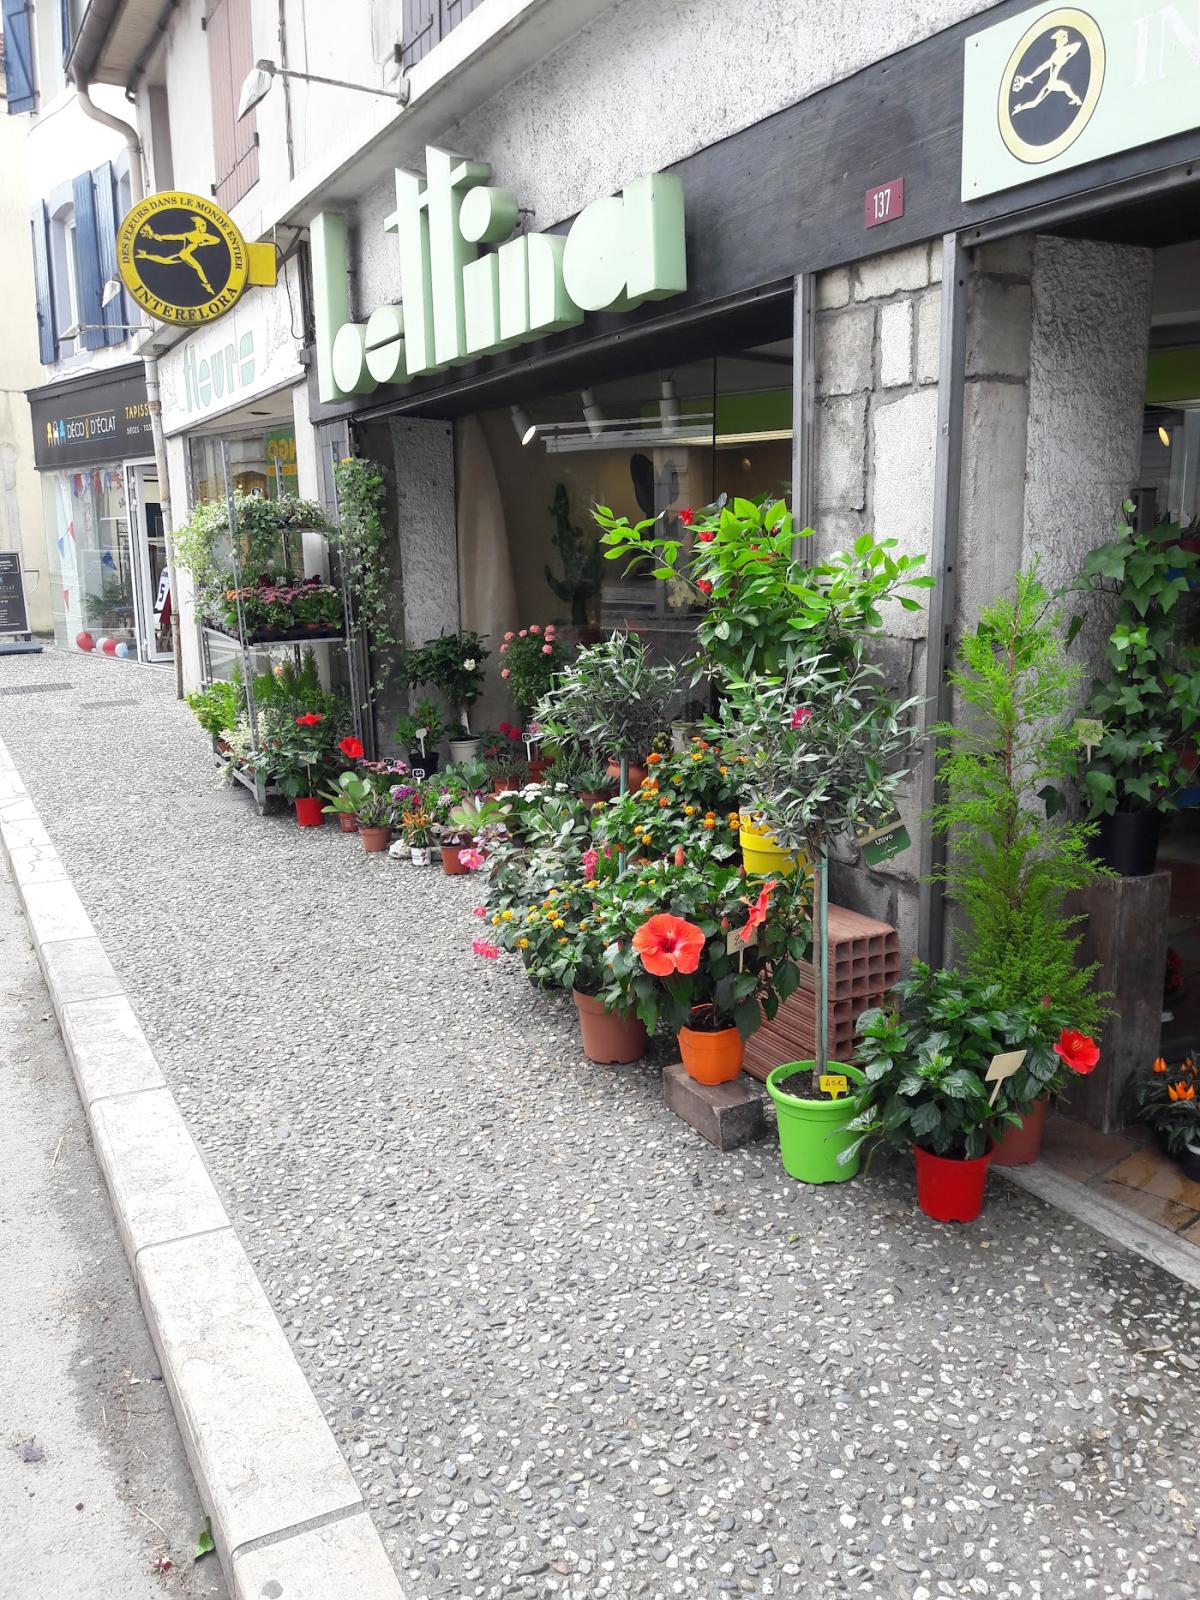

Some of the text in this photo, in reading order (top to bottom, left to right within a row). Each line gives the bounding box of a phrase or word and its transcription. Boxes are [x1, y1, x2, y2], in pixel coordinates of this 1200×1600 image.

[873, 188, 891, 219] 137
[121, 196, 243, 270] DES FLEURS DANS LE MONDE ENTIER
[132, 285, 238, 321] INTERFLORA
[125, 403, 150, 420] TAPISS
[67, 416, 116, 439] DÉCO D'ÉCLAT
[874, 834, 894, 846] Ulivo
